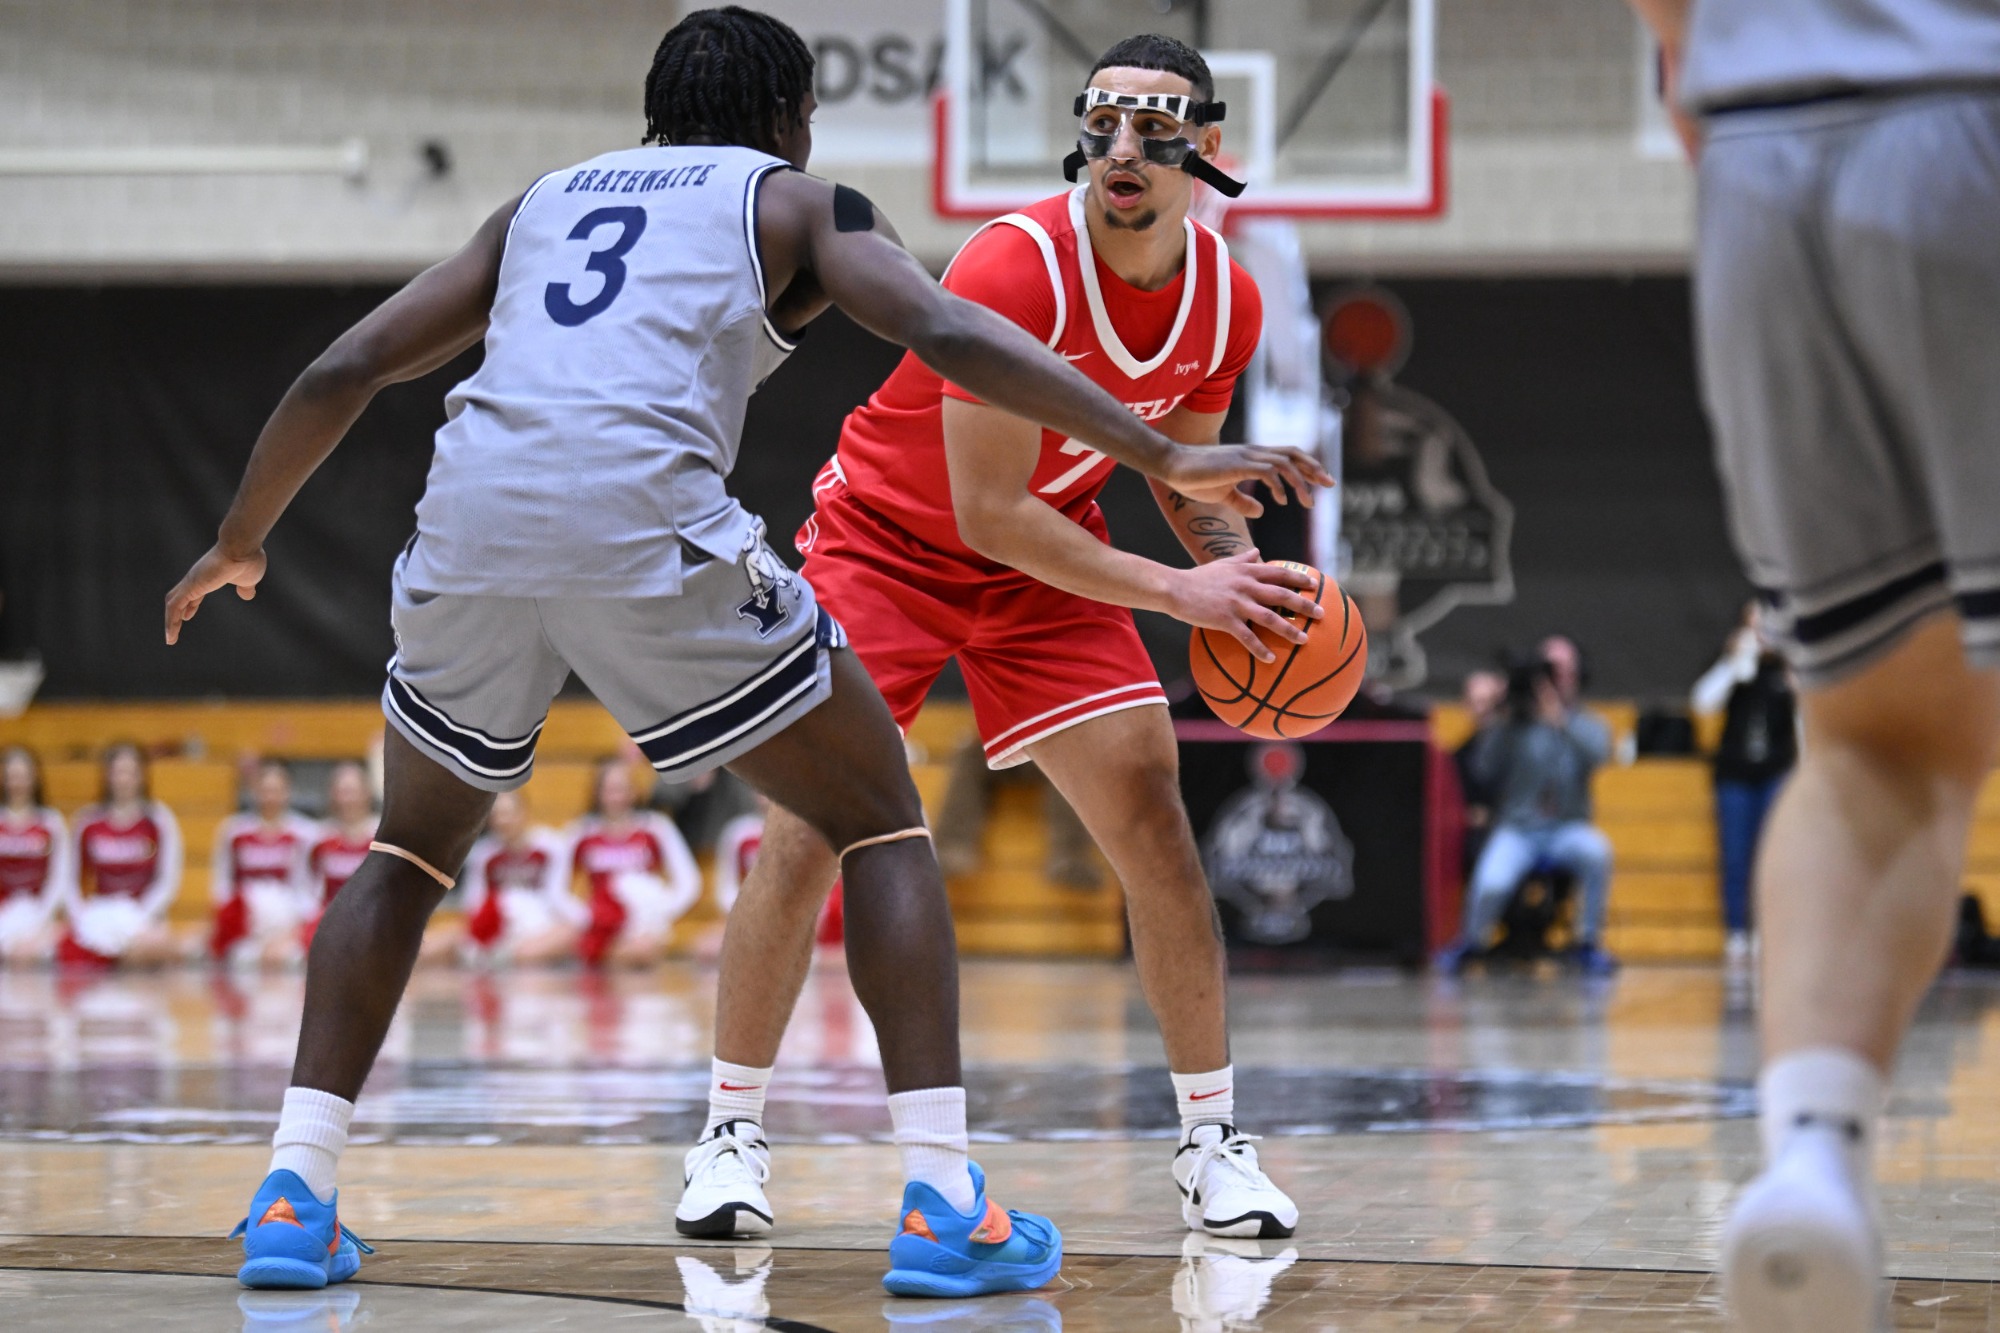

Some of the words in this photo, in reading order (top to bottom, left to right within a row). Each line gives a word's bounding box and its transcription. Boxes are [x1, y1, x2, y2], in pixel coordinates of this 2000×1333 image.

[563, 163, 719, 194] BRATHWAITE
[544, 205, 648, 328] 3
[1037, 436, 1108, 494] 7
